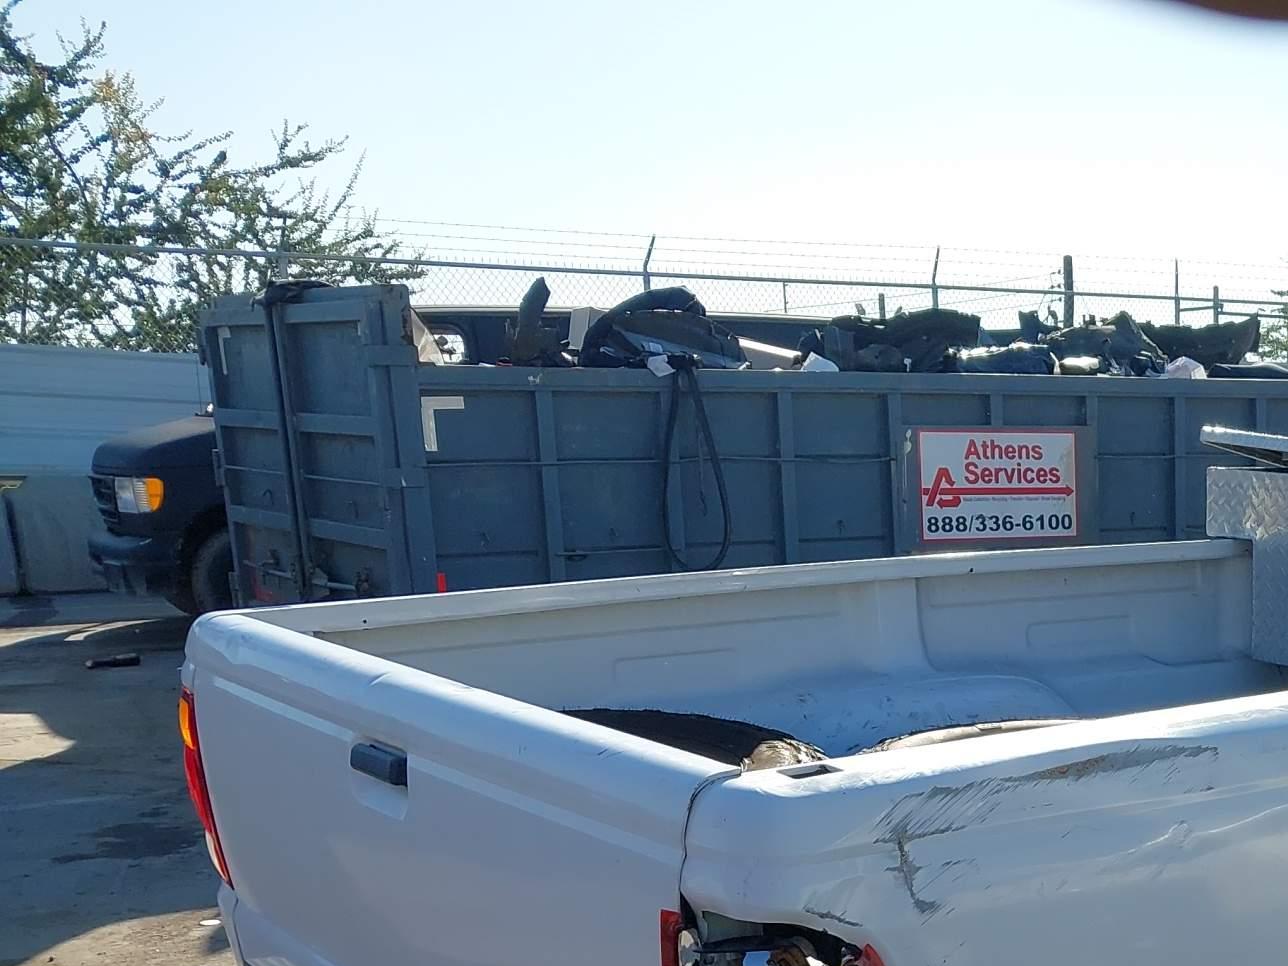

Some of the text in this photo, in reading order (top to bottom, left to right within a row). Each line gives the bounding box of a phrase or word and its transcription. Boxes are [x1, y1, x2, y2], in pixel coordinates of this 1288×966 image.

[964, 439, 1043, 460] Athens
[964, 462, 1061, 484] Services
[927, 514, 1073, 533] 888/336-6100
